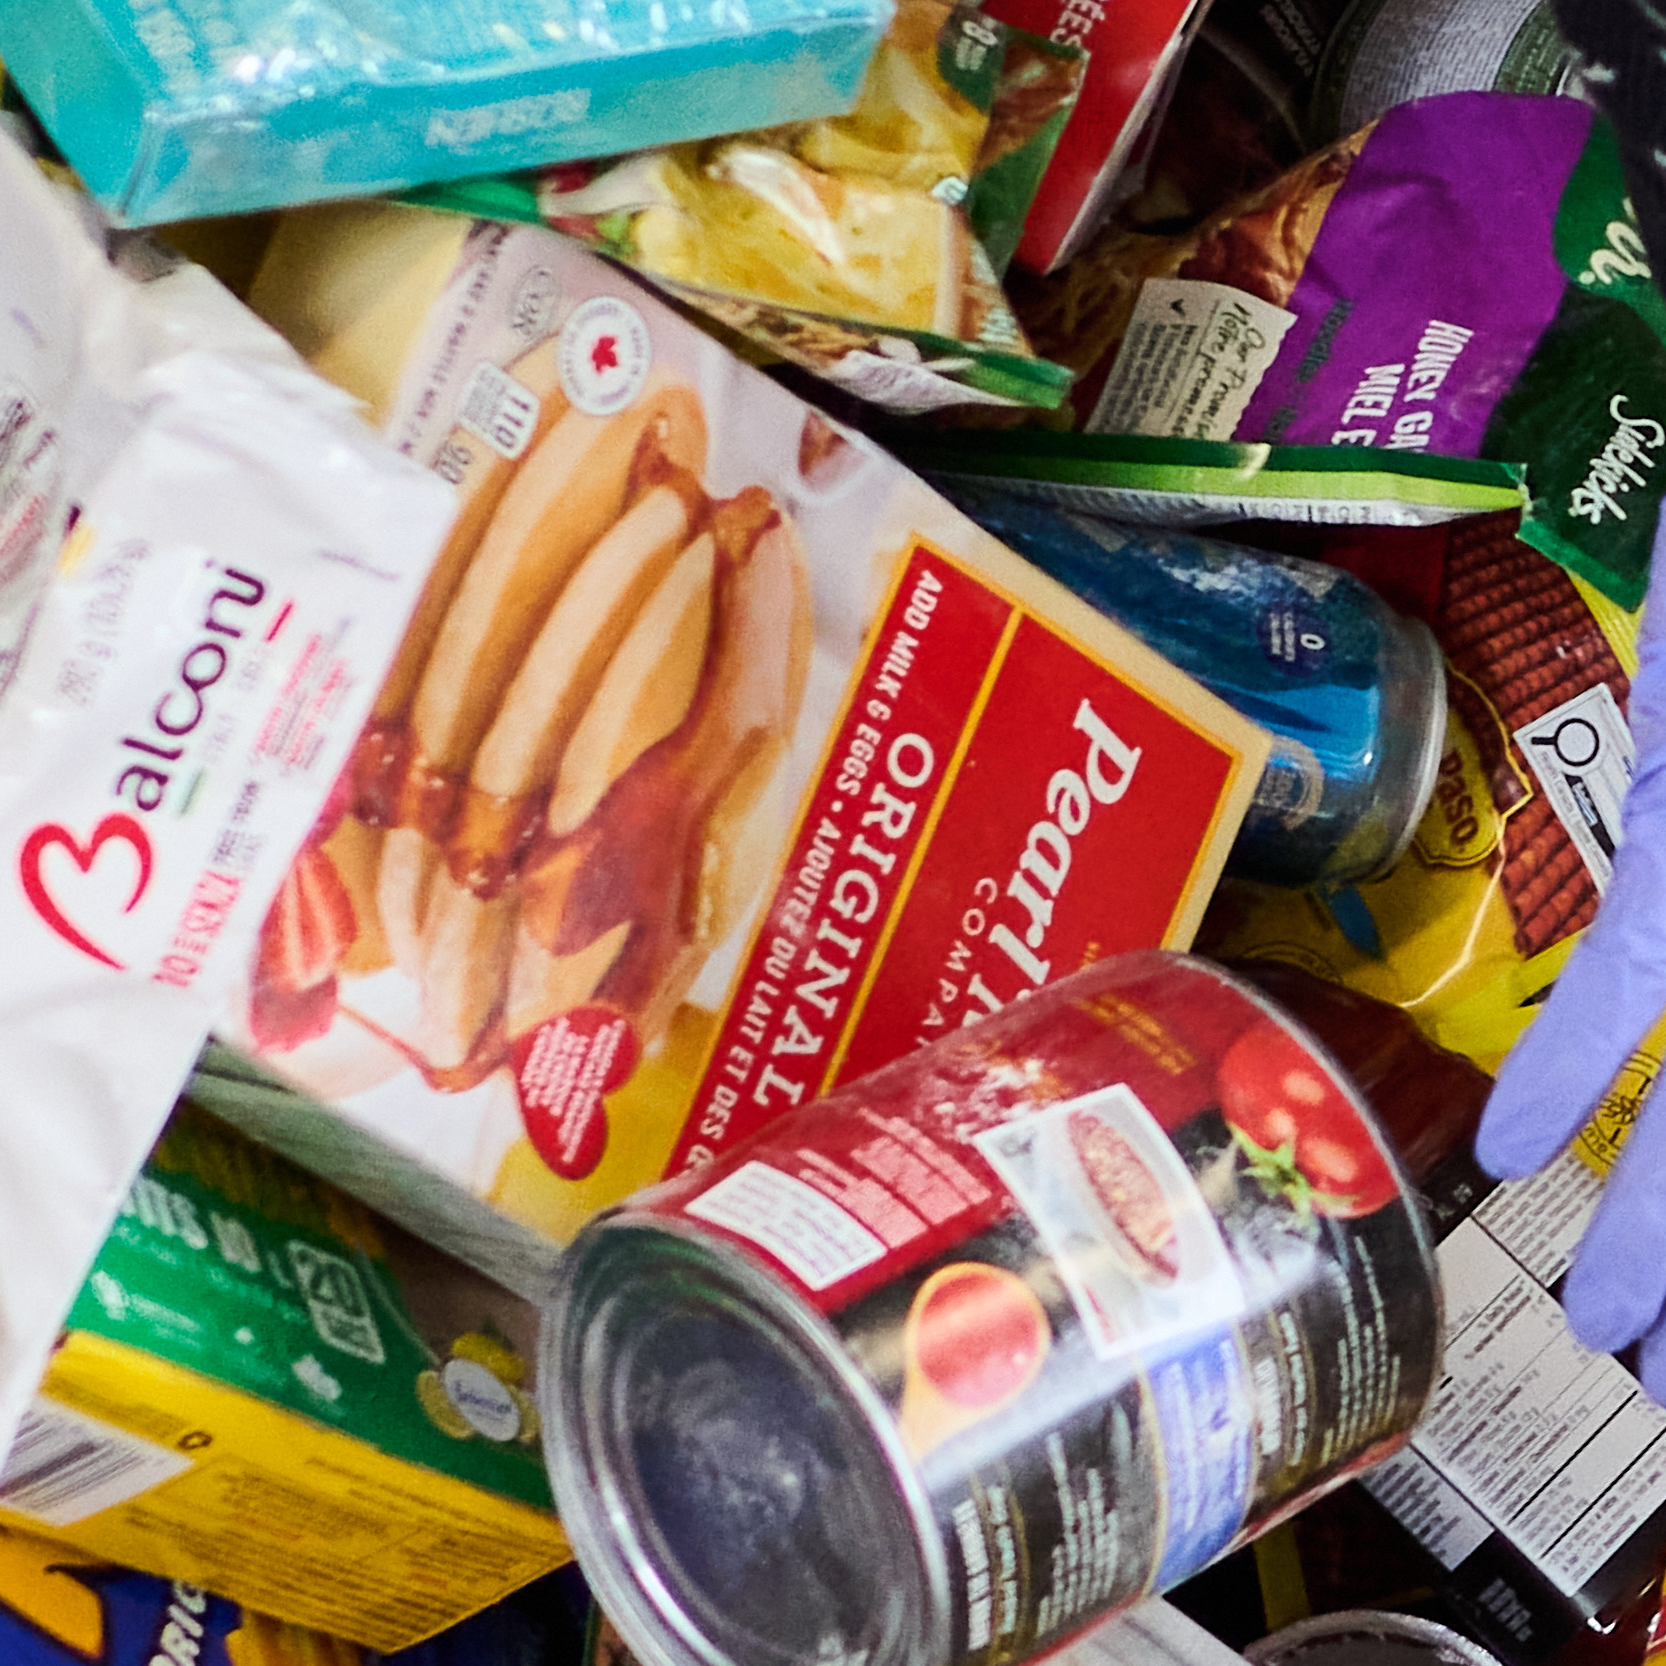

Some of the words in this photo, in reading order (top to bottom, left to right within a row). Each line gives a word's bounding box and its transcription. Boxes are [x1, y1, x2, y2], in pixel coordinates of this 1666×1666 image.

[1211, 300, 1252, 353] Notre
[1233, 327, 1268, 363] Our
[1340, 364, 1405, 422] MIEL
[1402, 320, 1474, 403] HONEY
[1567, 392, 1659, 523] Sidekicks
[899, 568, 945, 633] ADD
[874, 630, 921, 699] MILK
[17, 557, 269, 972] Balconi
[833, 722, 882, 797] EGGS
[988, 698, 1143, 985] Pearl
[778, 817, 843, 936] AJOUTEZ
[751, 727, 941, 1118] ORIGINAL
[761, 935, 796, 980] DU
[736, 978, 779, 1042] LAIT
[722, 1044, 755, 1081] ET
[698, 1084, 739, 1141] DES
